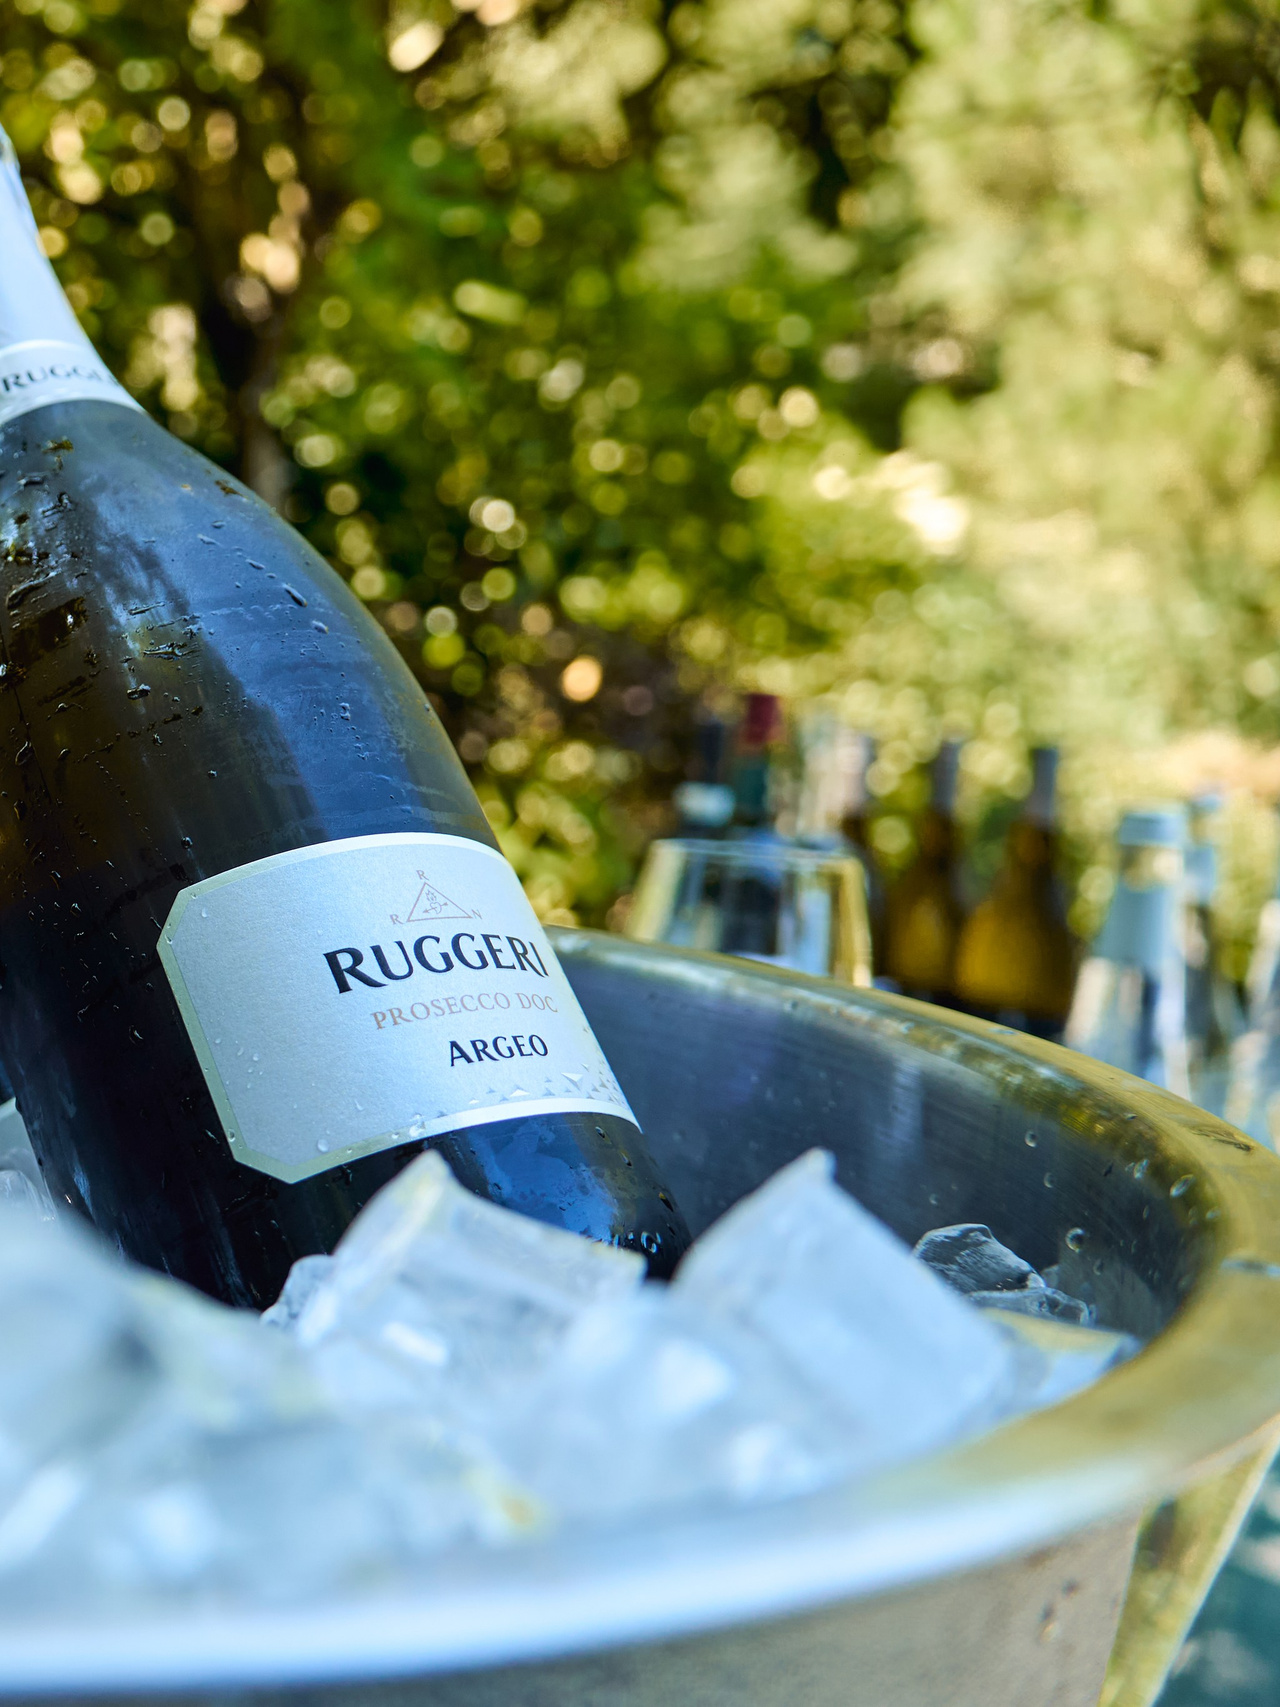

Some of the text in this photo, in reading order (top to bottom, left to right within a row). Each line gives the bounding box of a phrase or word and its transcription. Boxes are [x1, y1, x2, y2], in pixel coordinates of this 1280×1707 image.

[416, 870, 429, 881] R
[390, 909, 483, 925] R N
[323, 933, 550, 994] RUGGERI
[370, 992, 558, 1030] PROSECCO DOC
[448, 1034, 549, 1067] ARGEO
